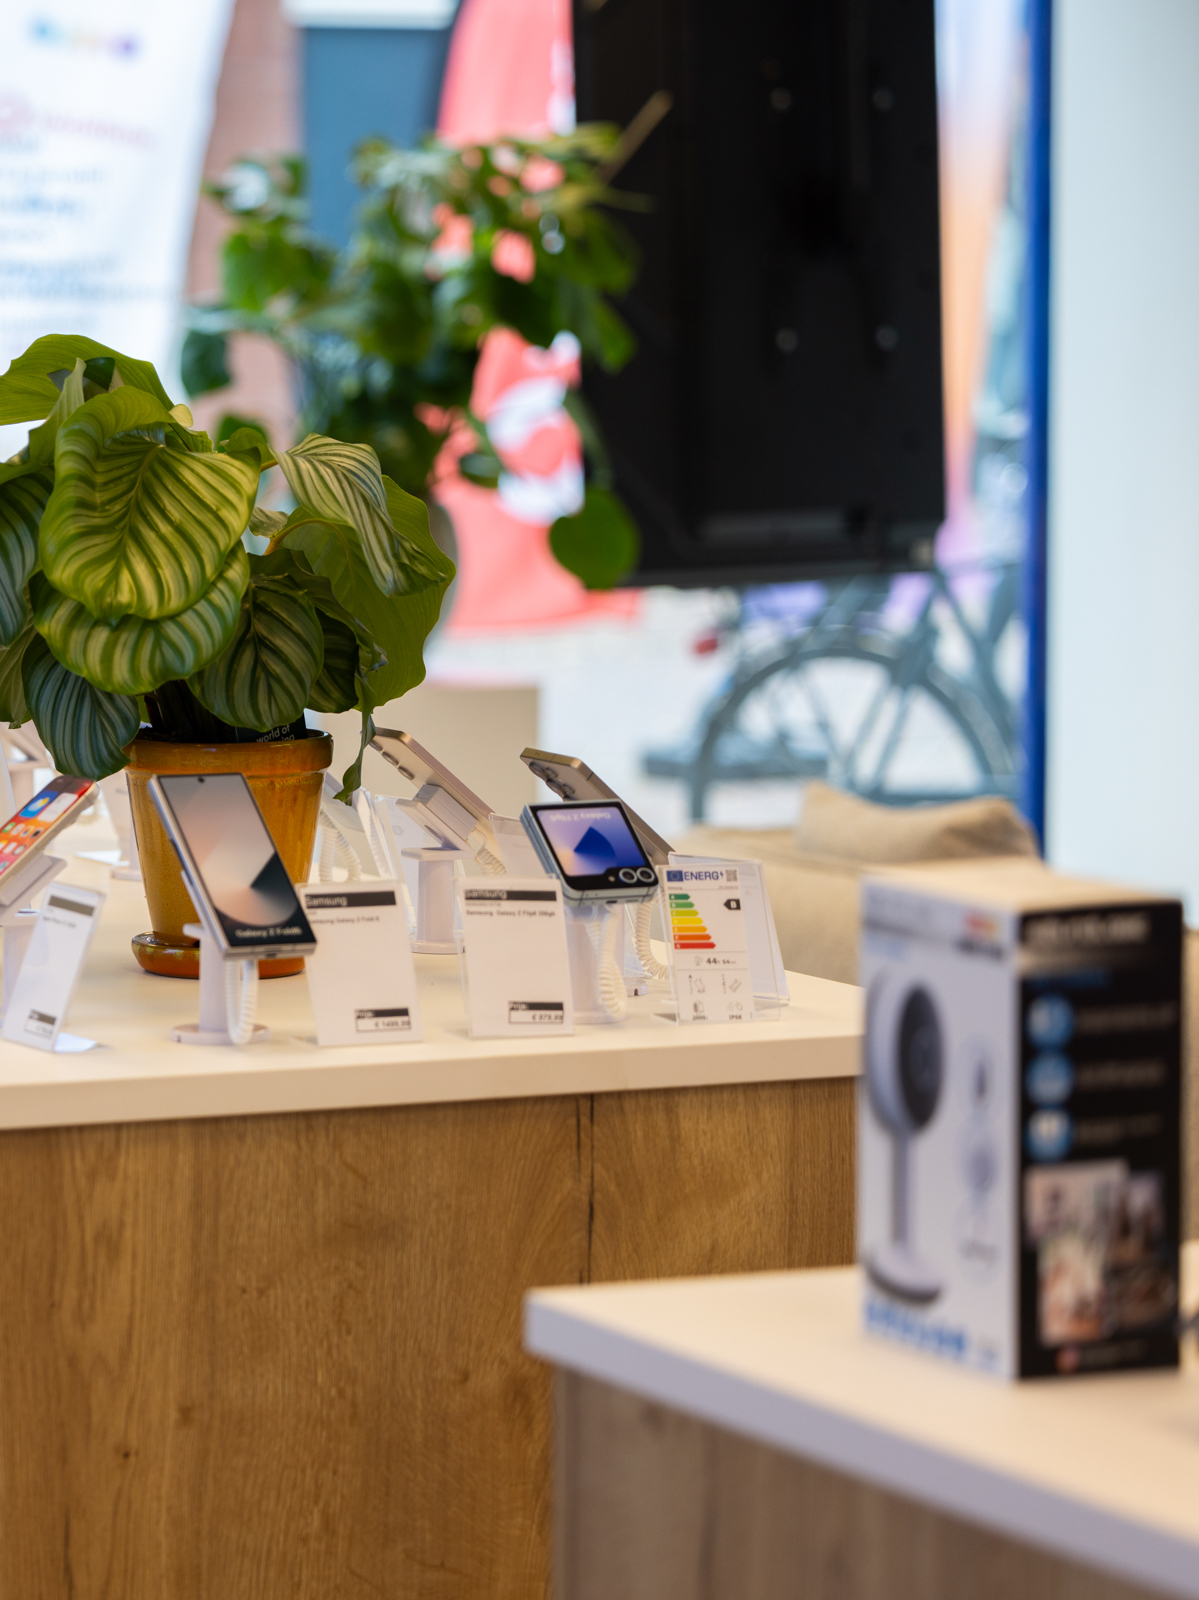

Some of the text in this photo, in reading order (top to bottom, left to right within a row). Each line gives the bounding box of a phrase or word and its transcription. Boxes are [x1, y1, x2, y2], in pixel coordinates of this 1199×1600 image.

[256, 724, 290, 743] world of
[683, 871, 720, 881] ENERG
[465, 890, 508, 900] Samsung
[306, 896, 348, 908] Samsung
[730, 900, 737, 909] B
[309, 917, 334, 925] amsung
